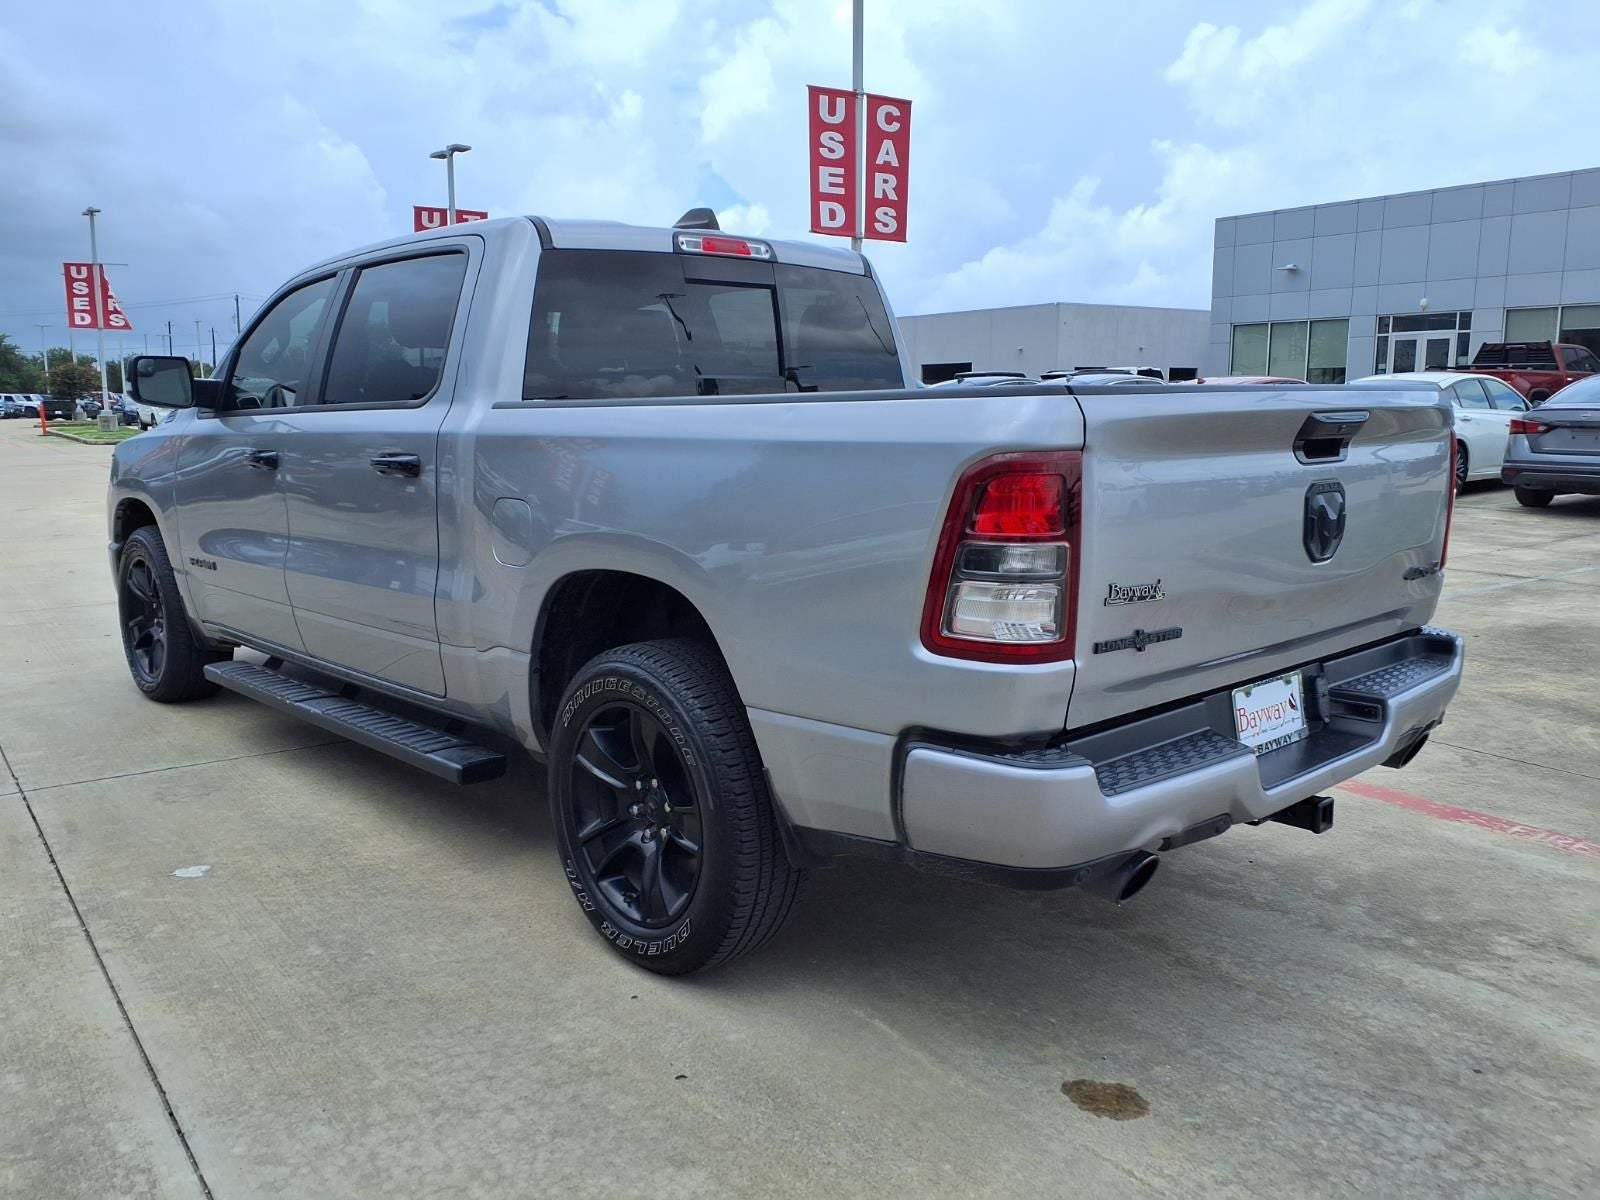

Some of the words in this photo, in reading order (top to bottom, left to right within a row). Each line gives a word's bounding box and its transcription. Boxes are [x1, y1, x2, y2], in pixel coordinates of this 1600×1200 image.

[819, 95, 846, 228] USED
[874, 105, 901, 234] CARS
[70, 266, 92, 325] USED
[1236, 700, 1288, 734] Bayway
[600, 918, 691, 956] DUELER
